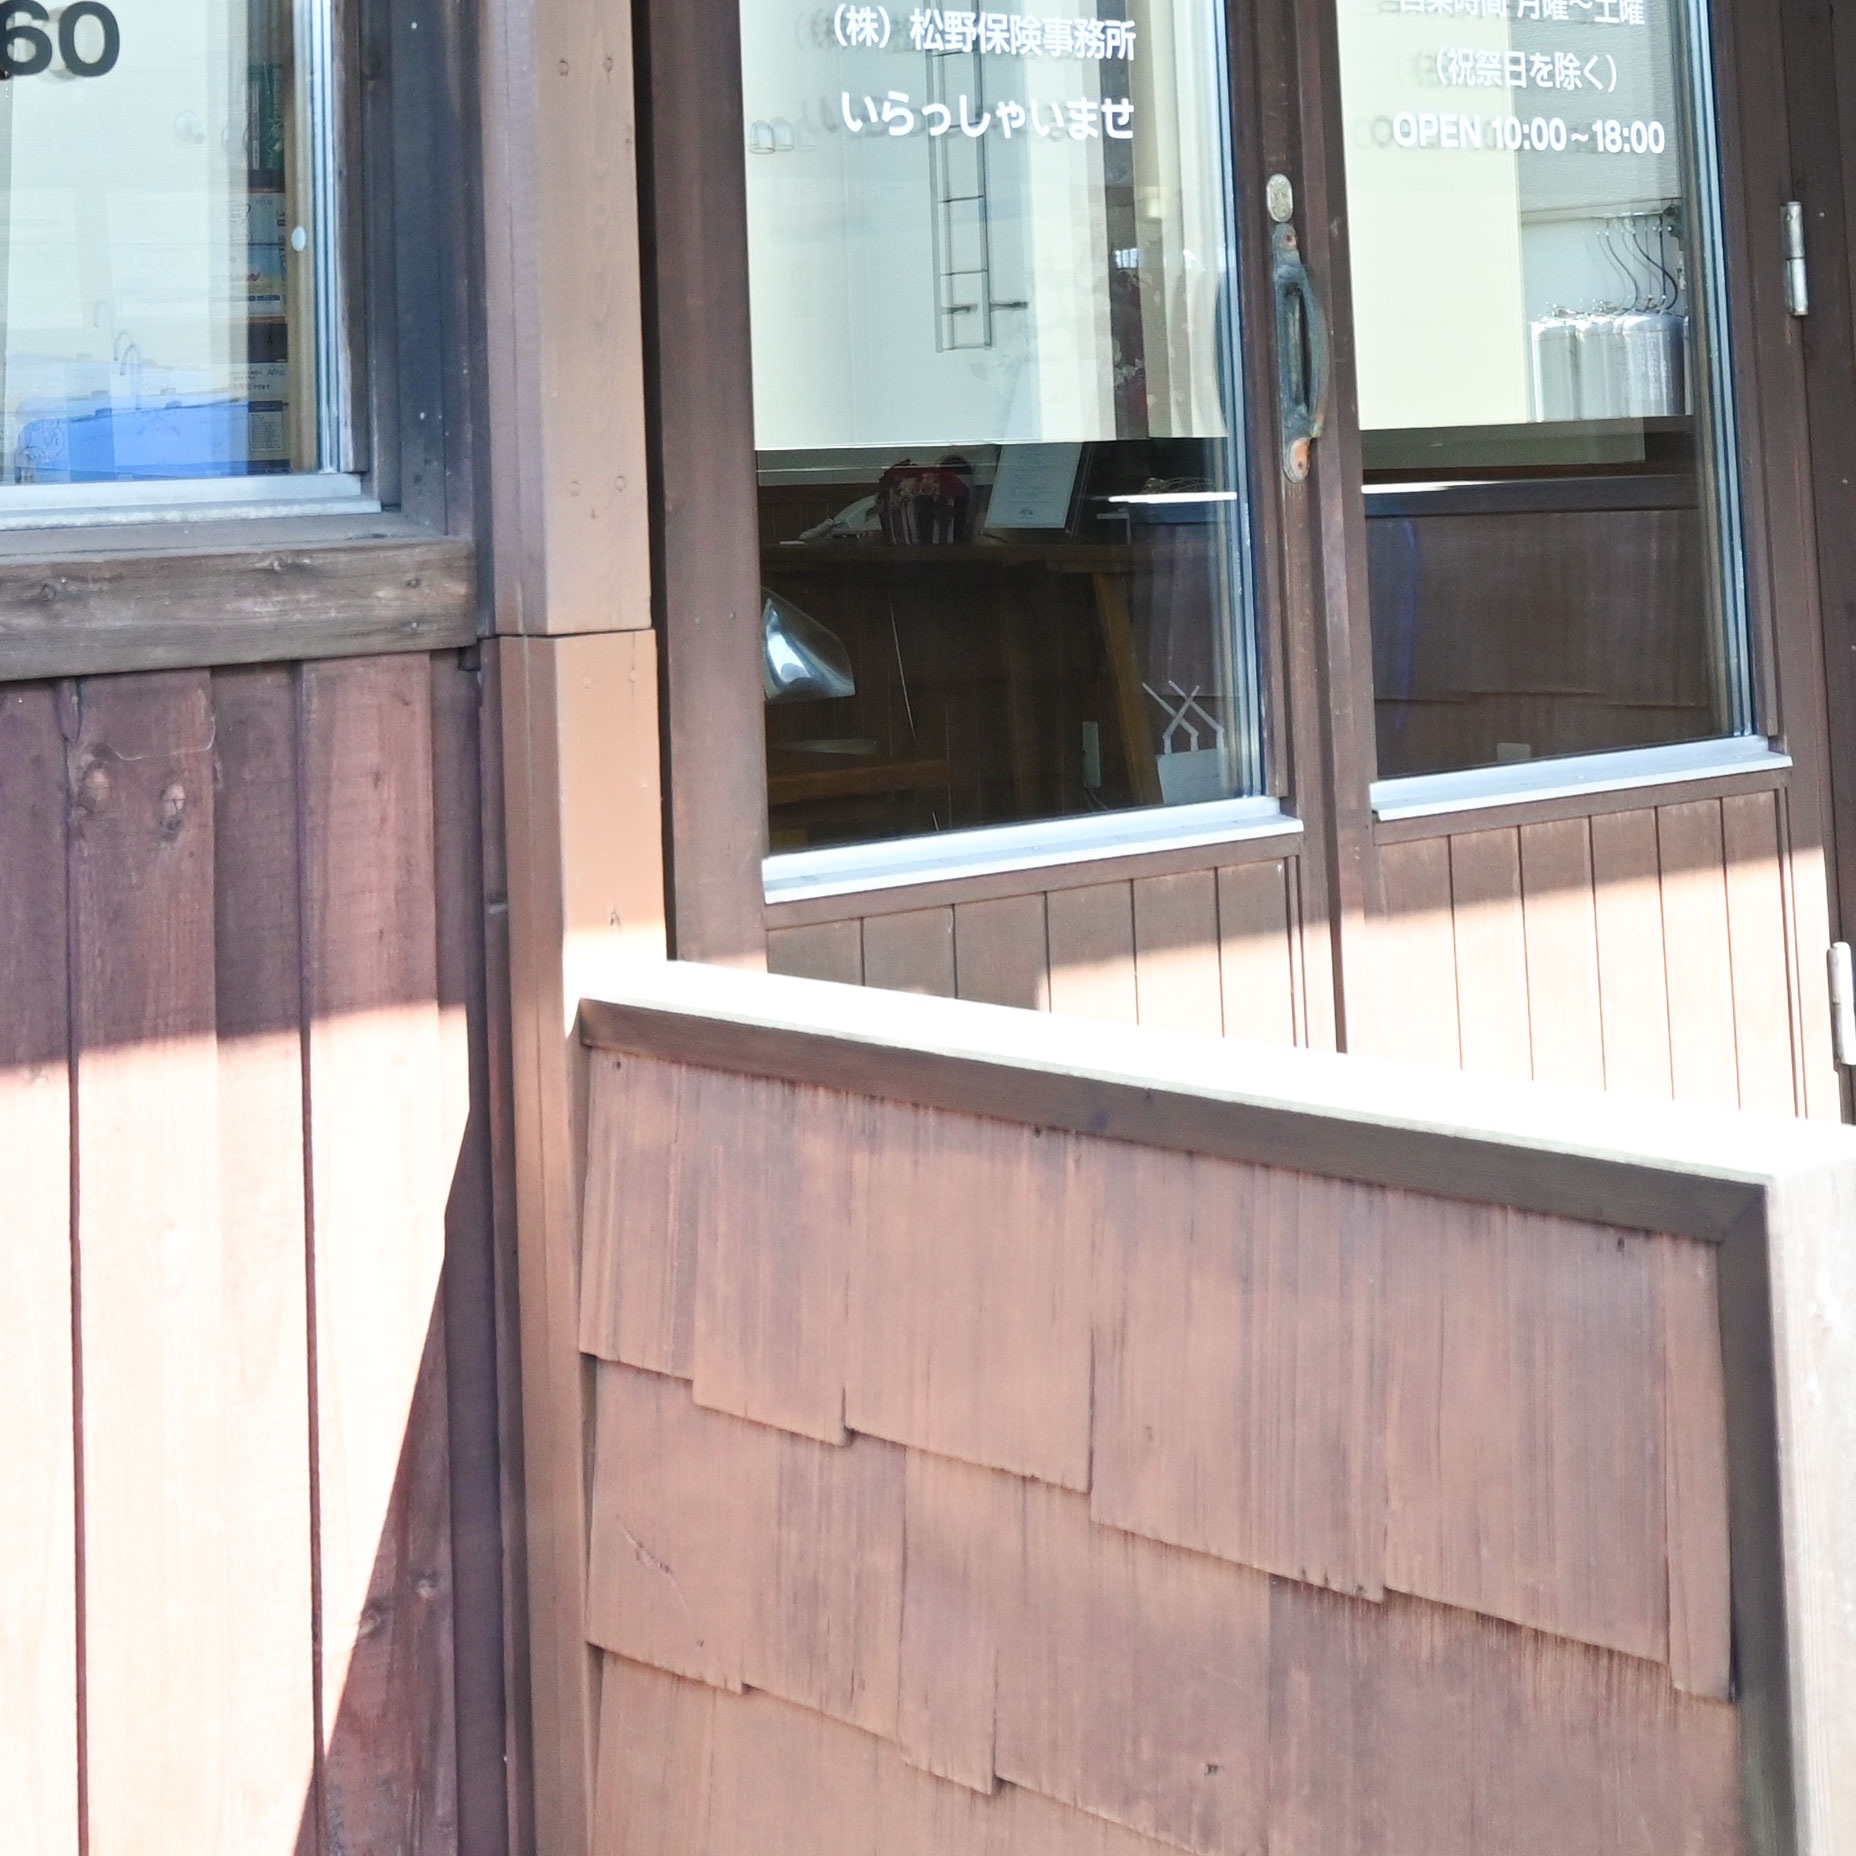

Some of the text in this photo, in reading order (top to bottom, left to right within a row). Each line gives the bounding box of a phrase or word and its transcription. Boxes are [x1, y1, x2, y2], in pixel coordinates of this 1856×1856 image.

[841, 90, 1135, 139] いらっしゃいませ
[1392, 111, 1483, 150] OPEN
